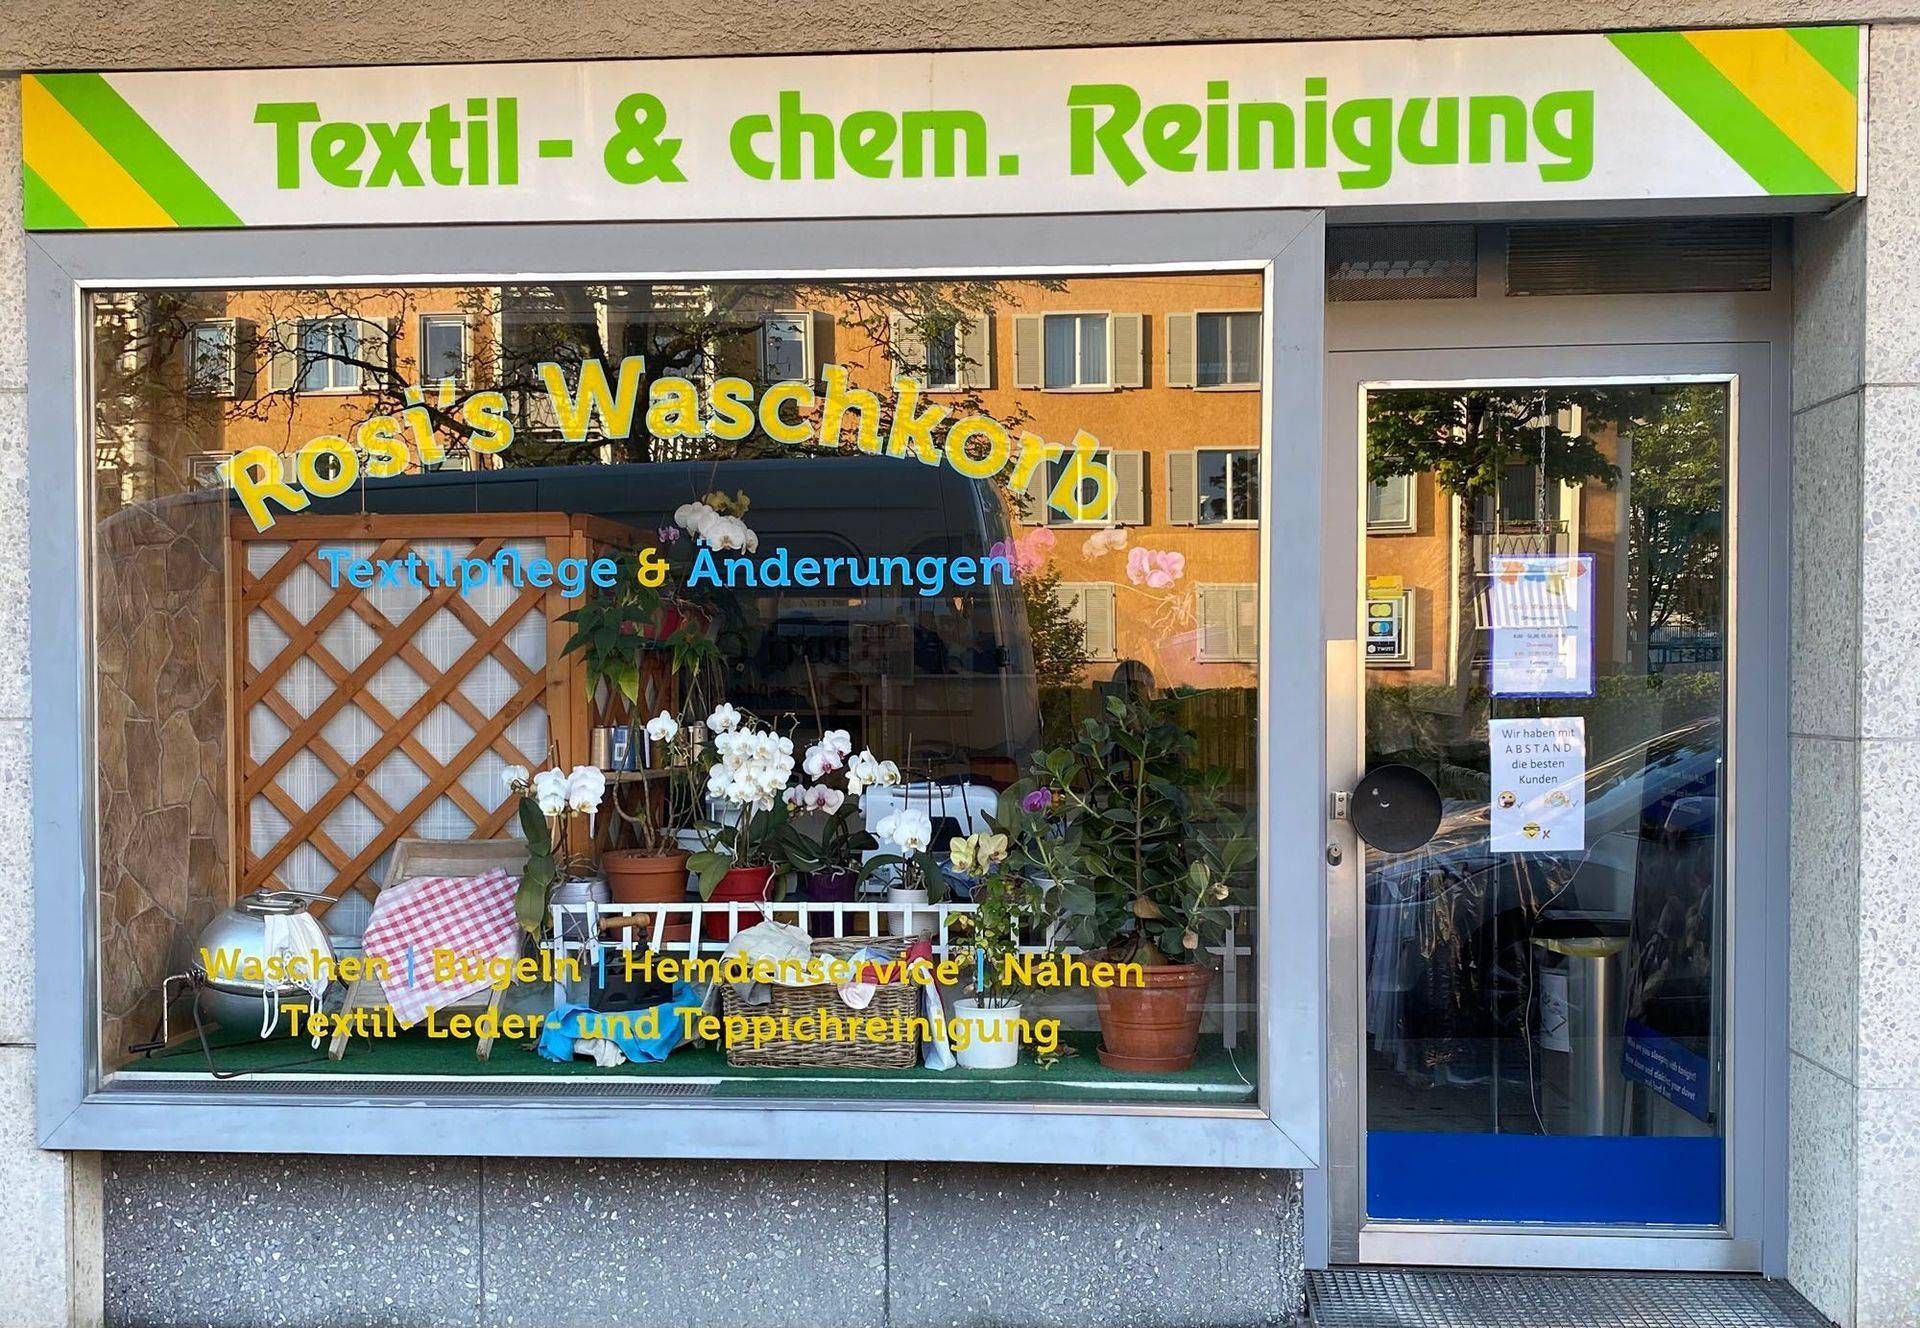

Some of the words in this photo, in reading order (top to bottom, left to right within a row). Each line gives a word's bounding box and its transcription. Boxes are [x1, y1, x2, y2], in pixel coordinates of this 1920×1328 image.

[603, 92, 688, 188] &
[729, 90, 1020, 183] chem.
[1066, 77, 1595, 191] Reinigung
[216, 375, 515, 533] Rosi's
[537, 356, 1119, 523] Waschkorb
[318, 548, 620, 598] Textilpflege
[637, 548, 670, 588] &
[687, 538, 1014, 597] Änderungen
[1501, 729, 1521, 739] Wir
[1523, 728, 1556, 738] haben
[1558, 728, 1576, 738] mit
[1511, 759, 1528, 770] die
[1530, 759, 1565, 769] besten
[1519, 775, 1559, 785] Kunden
[200, 946, 389, 984] Waschen
[432, 949, 582, 991] Bügeln
[624, 950, 960, 986] Hemdenservice
[1002, 953, 1146, 989] Nähen
[576, 1006, 661, 1040] und
[673, 1006, 1061, 1055] Teppichreinigung
